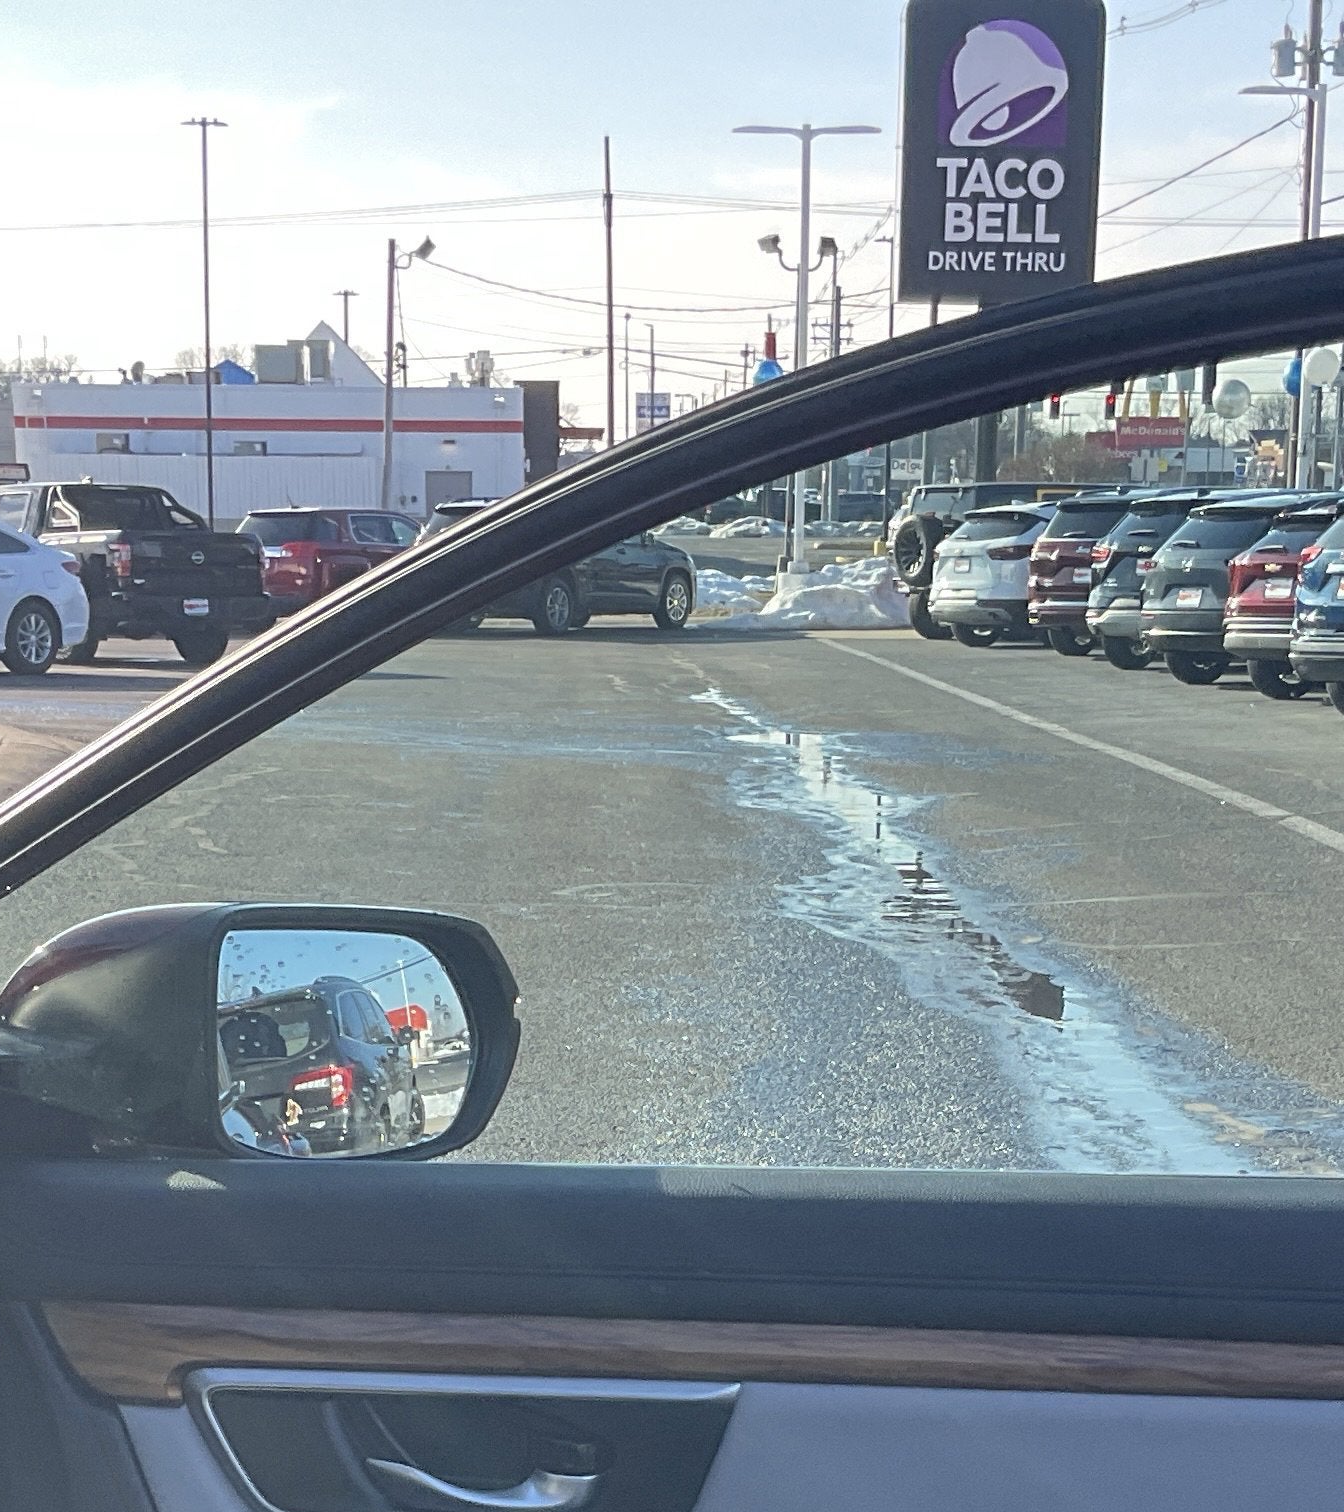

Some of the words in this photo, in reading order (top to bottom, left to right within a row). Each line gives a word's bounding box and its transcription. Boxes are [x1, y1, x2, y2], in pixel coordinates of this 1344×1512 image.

[936, 157, 1065, 200] TACO
[944, 202, 1060, 243] BELL
[928, 250, 996, 271] DRIVE
[1002, 251, 1065, 272] THRU
[1120, 426, 1186, 436] McDonald's
